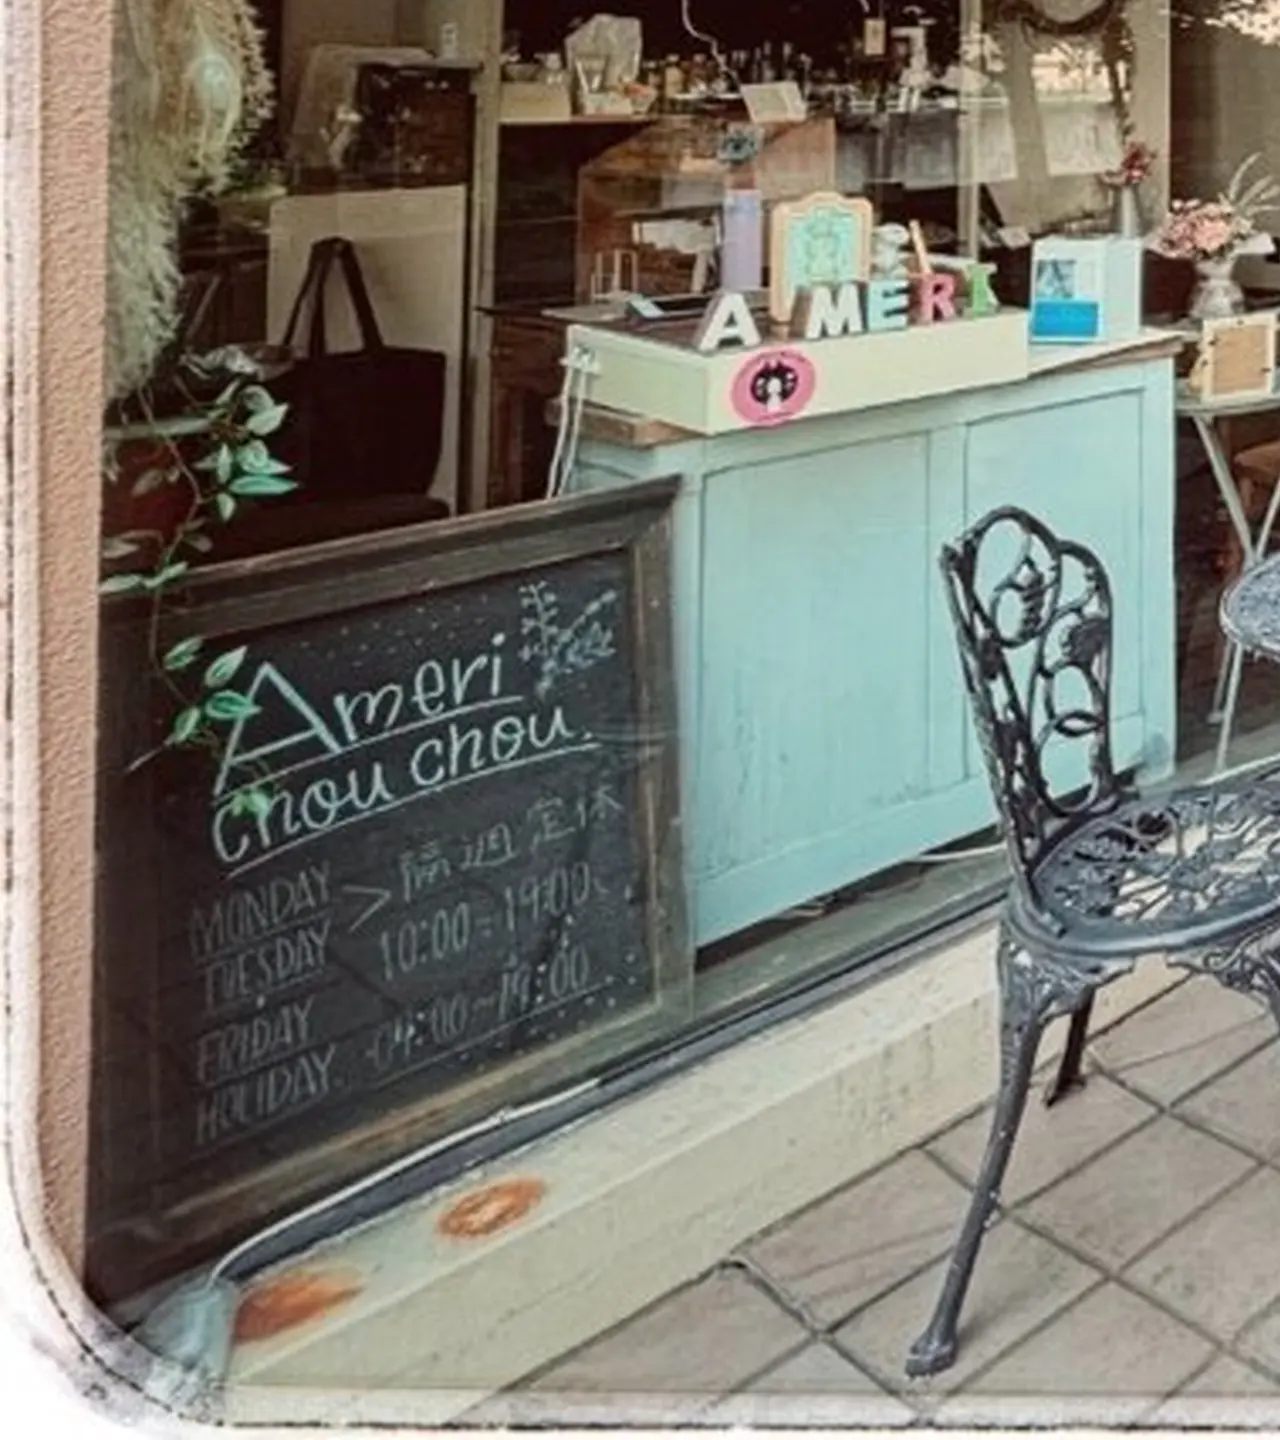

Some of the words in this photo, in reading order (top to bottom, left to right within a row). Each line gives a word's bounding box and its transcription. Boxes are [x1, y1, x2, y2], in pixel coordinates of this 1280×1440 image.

[212, 634, 508, 798] Ameri
[190, 859, 334, 957] MONDAY
[204, 917, 334, 1014] TUESDAY
[196, 994, 316, 1088] FRIDAY
